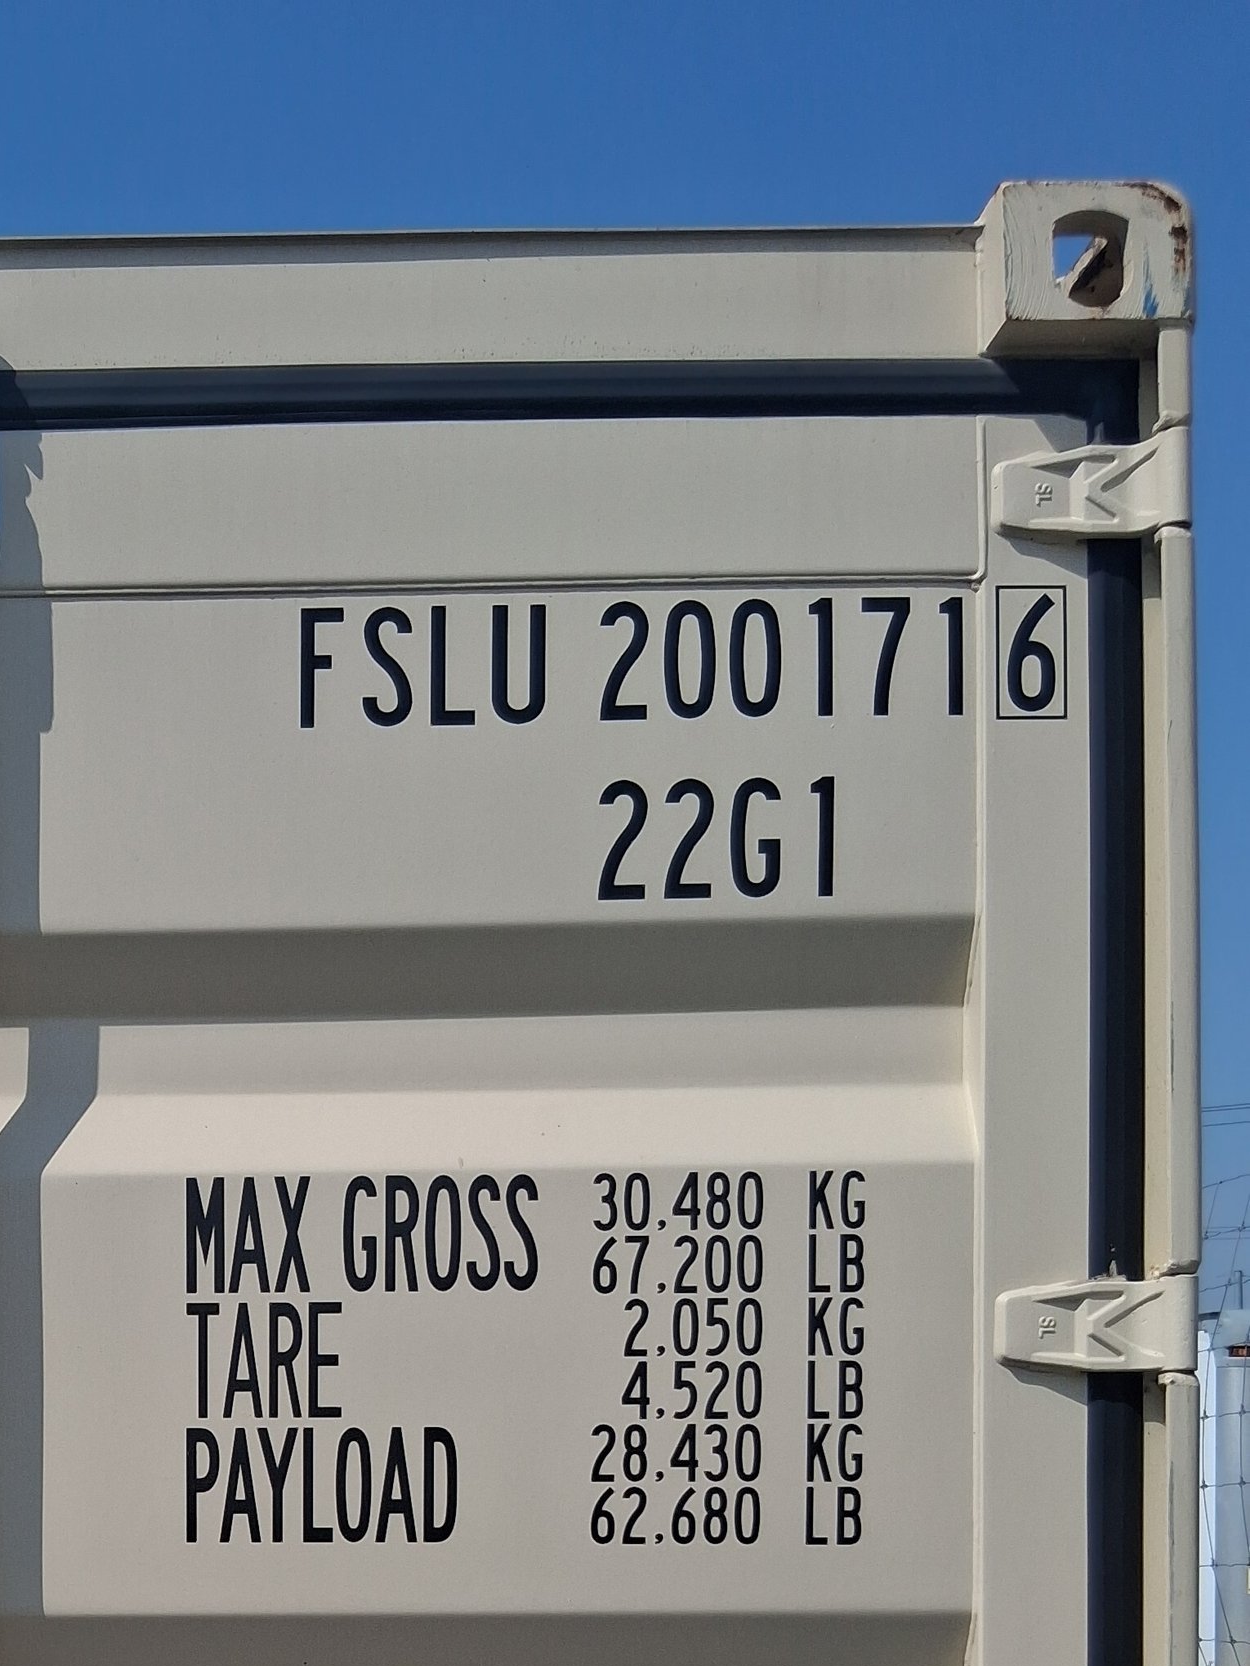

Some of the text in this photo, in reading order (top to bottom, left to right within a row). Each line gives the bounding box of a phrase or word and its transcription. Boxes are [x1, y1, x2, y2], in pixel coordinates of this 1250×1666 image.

[1035, 482, 1053, 507] SL
[299, 603, 547, 729] FSLU
[599, 596, 964, 721] 200171
[597, 775, 835, 901] 22G1
[593, 1170, 866, 1232] 30,480 KG
[185, 1174, 539, 1294] MAX GROSS
[592, 1233, 865, 1295] 67,200 LB
[623, 1296, 865, 1357] 2,050 KG
[1038, 1316, 1057, 1339] SL
[186, 1301, 343, 1419] TARE
[621, 1360, 864, 1420] 4,520 LB
[591, 1423, 863, 1483] 28,430 KG
[186, 1426, 458, 1543] PAYLOAD
[590, 1486, 862, 1546] 62,680 LB
